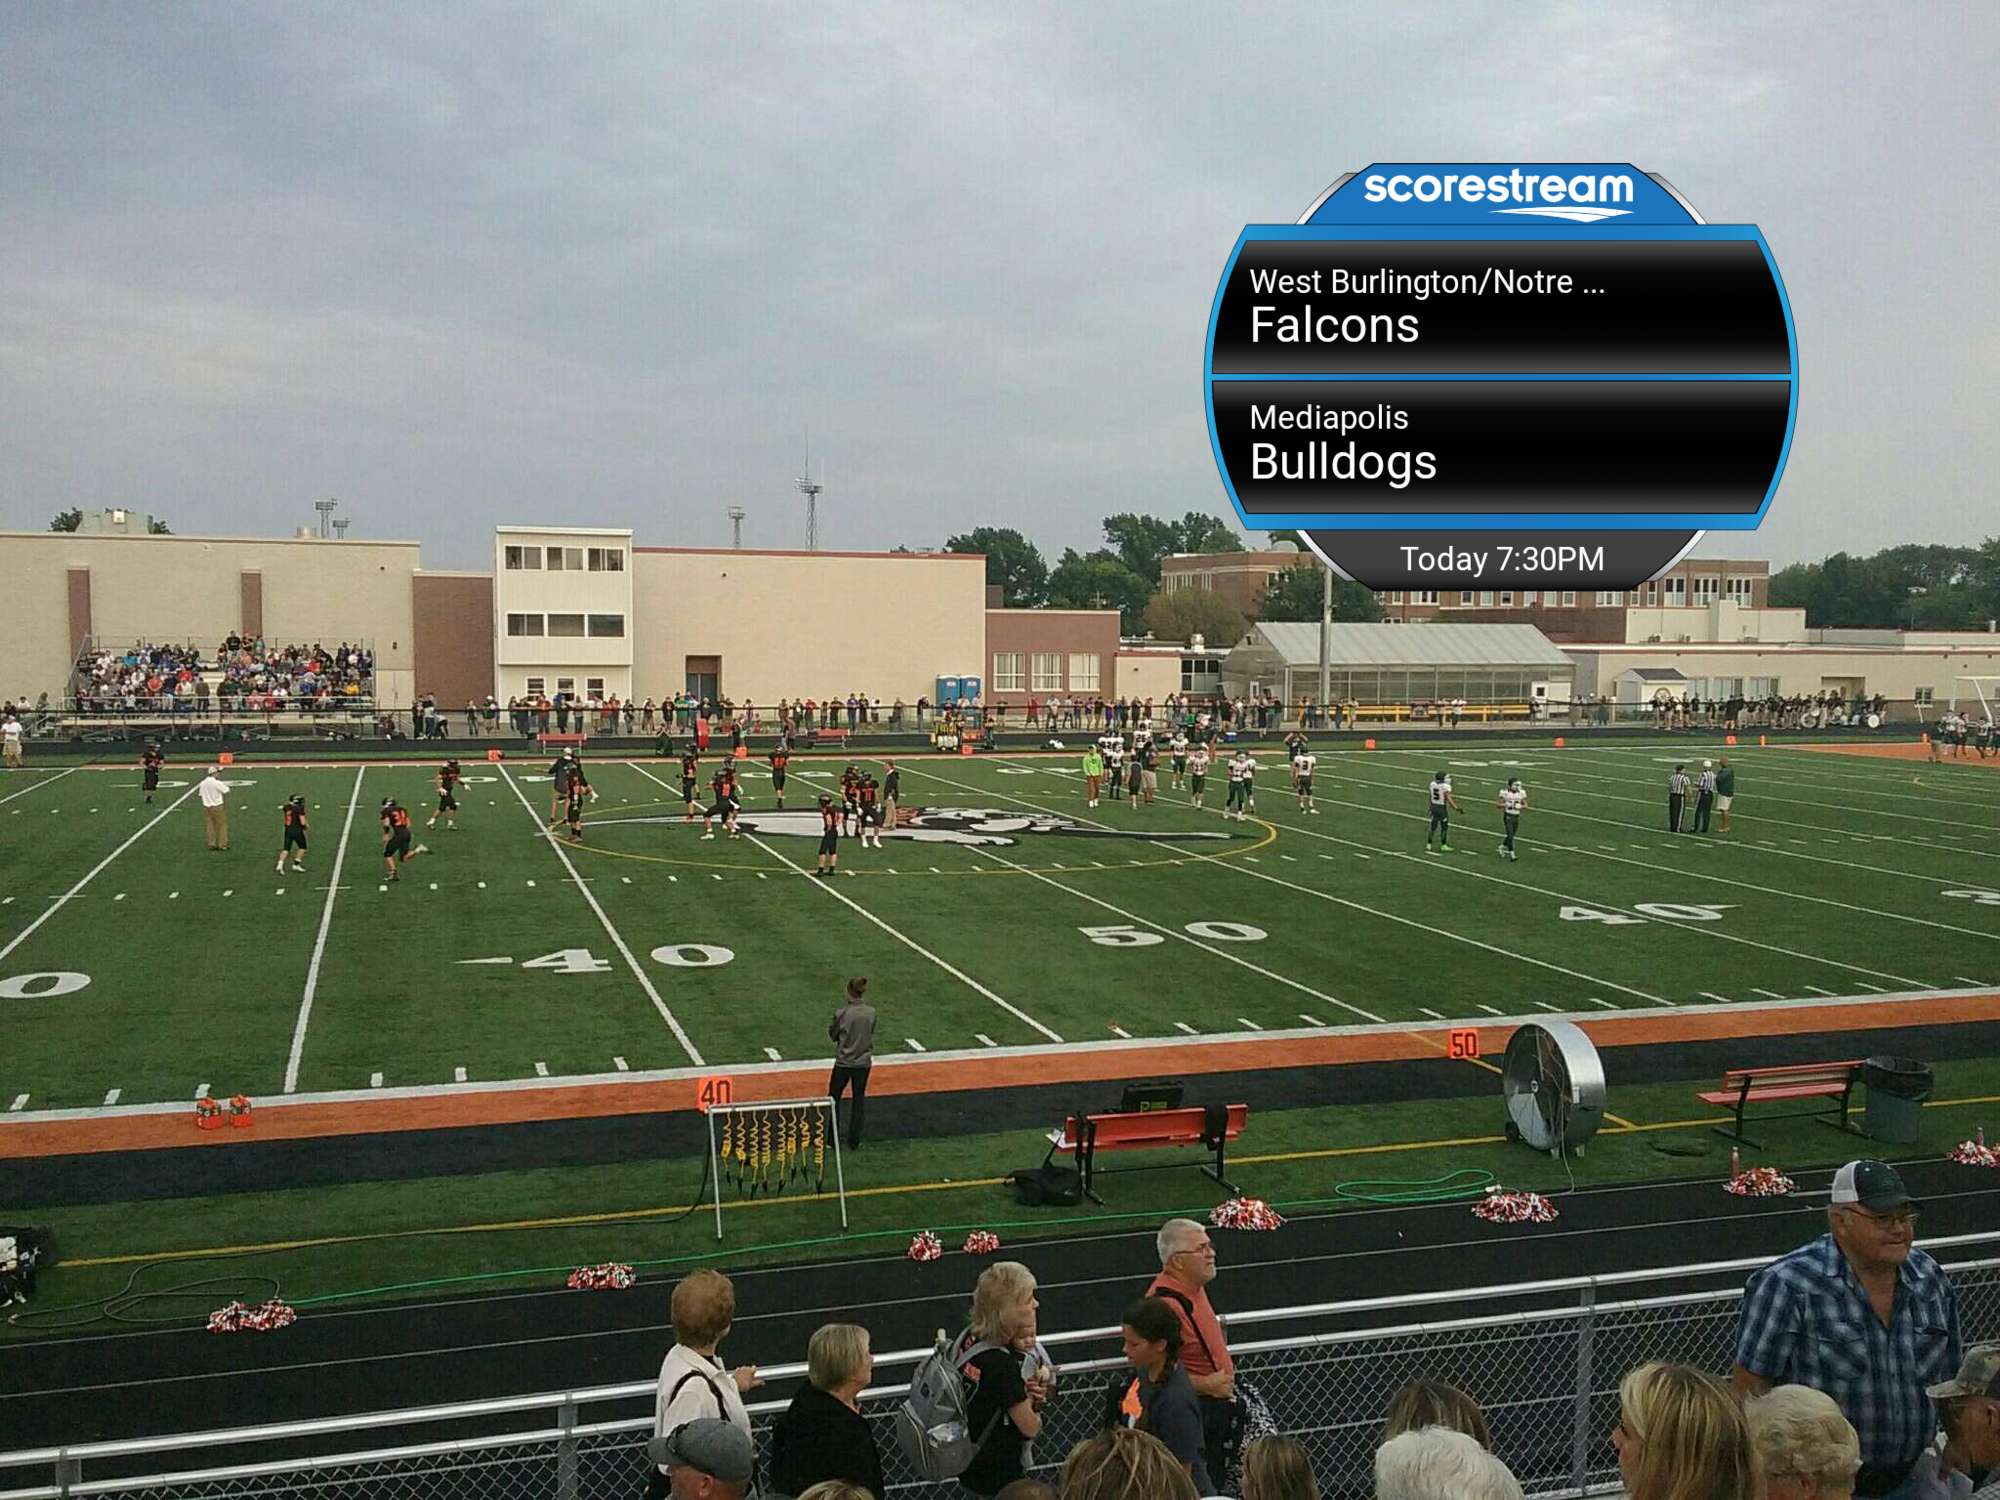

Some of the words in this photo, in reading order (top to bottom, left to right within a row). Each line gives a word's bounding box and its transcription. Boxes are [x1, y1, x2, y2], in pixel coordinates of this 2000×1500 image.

[1077, 922, 1268, 946] 50
[522, 944, 734, 973] 40
[1452, 1032, 1477, 1056] 50
[701, 1080, 730, 1105] 40
